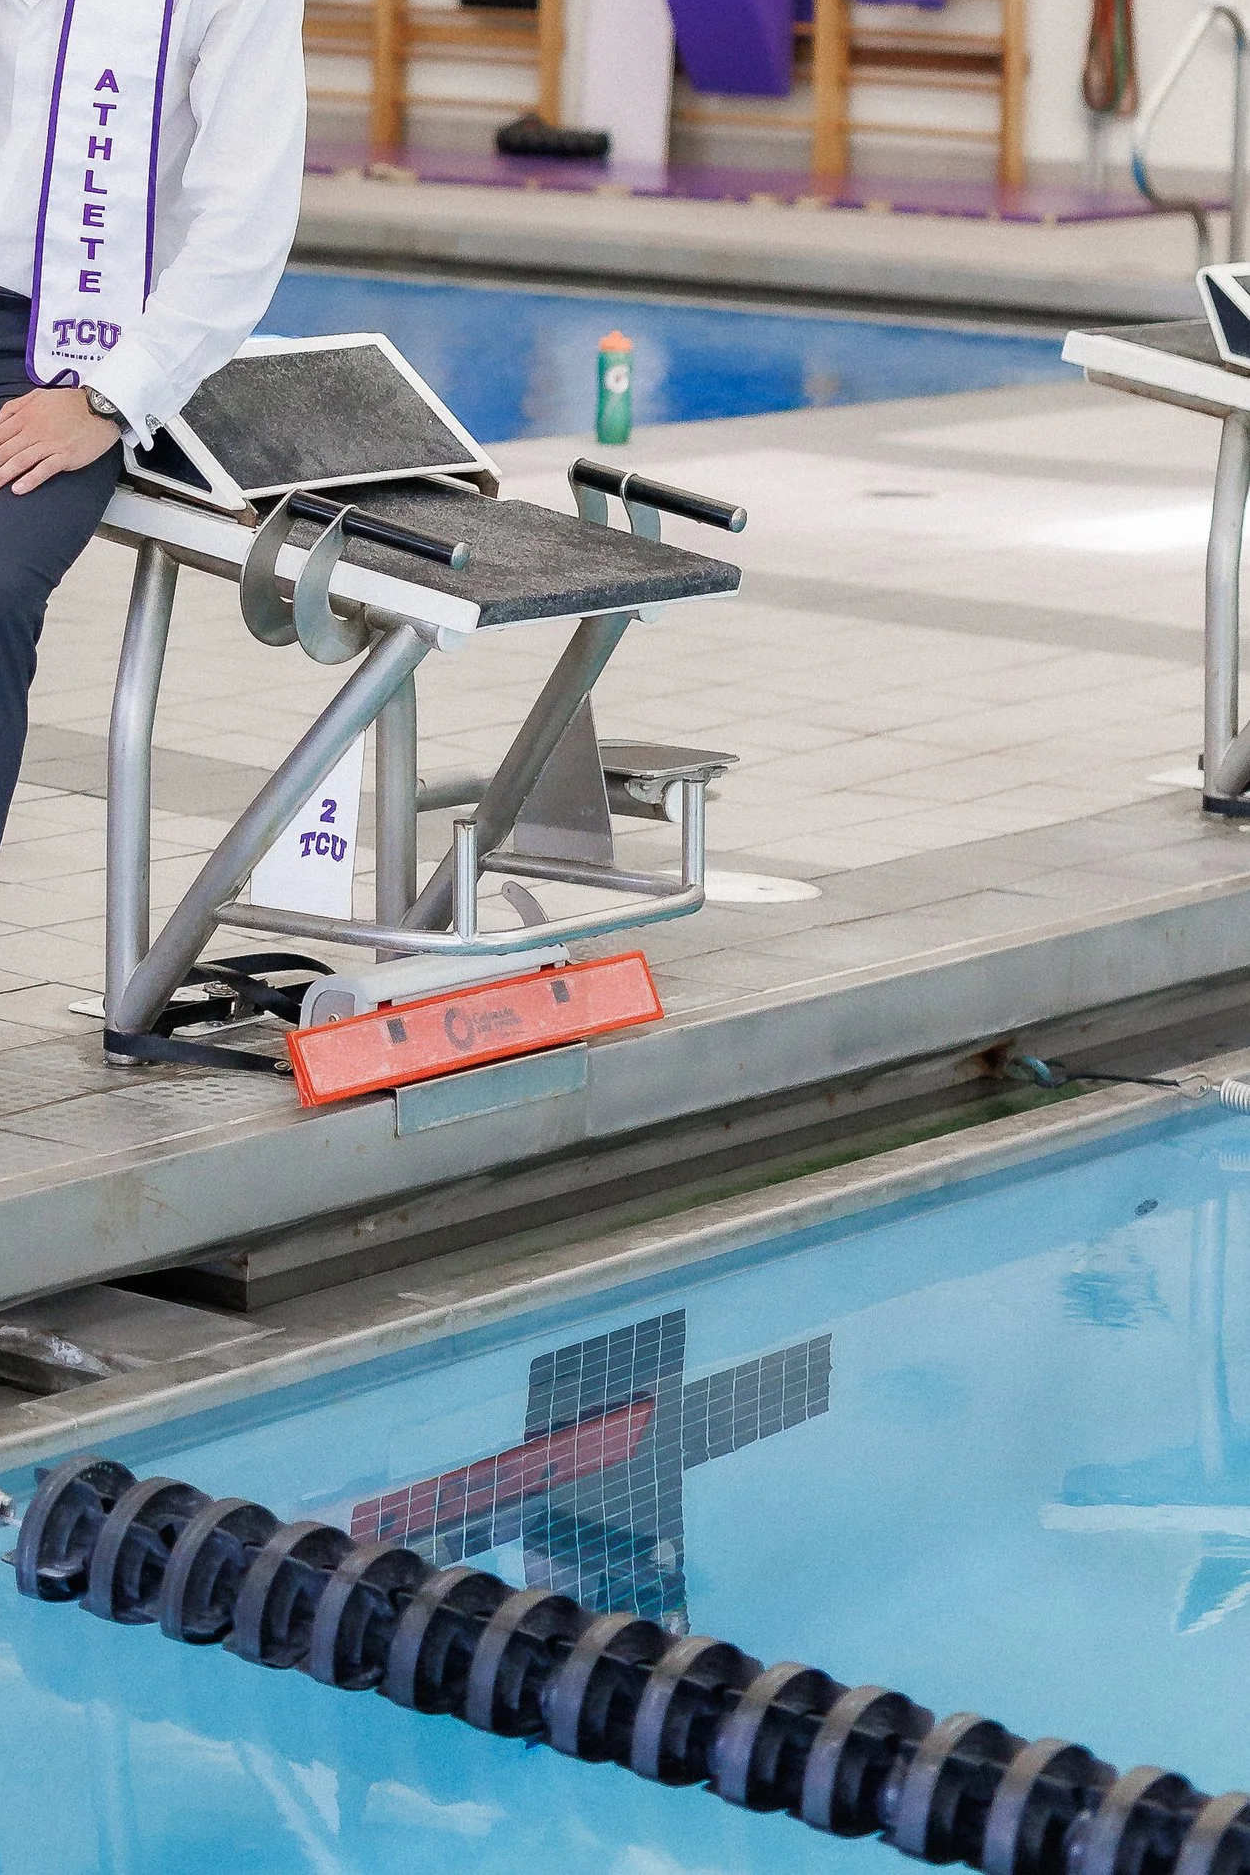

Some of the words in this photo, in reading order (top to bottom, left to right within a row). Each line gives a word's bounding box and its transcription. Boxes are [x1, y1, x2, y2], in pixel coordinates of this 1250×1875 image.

[78, 69, 120, 294] ATHLETE
[52, 318, 122, 352] TCU
[319, 798, 338, 824] 2
[299, 831, 348, 863] TCU
